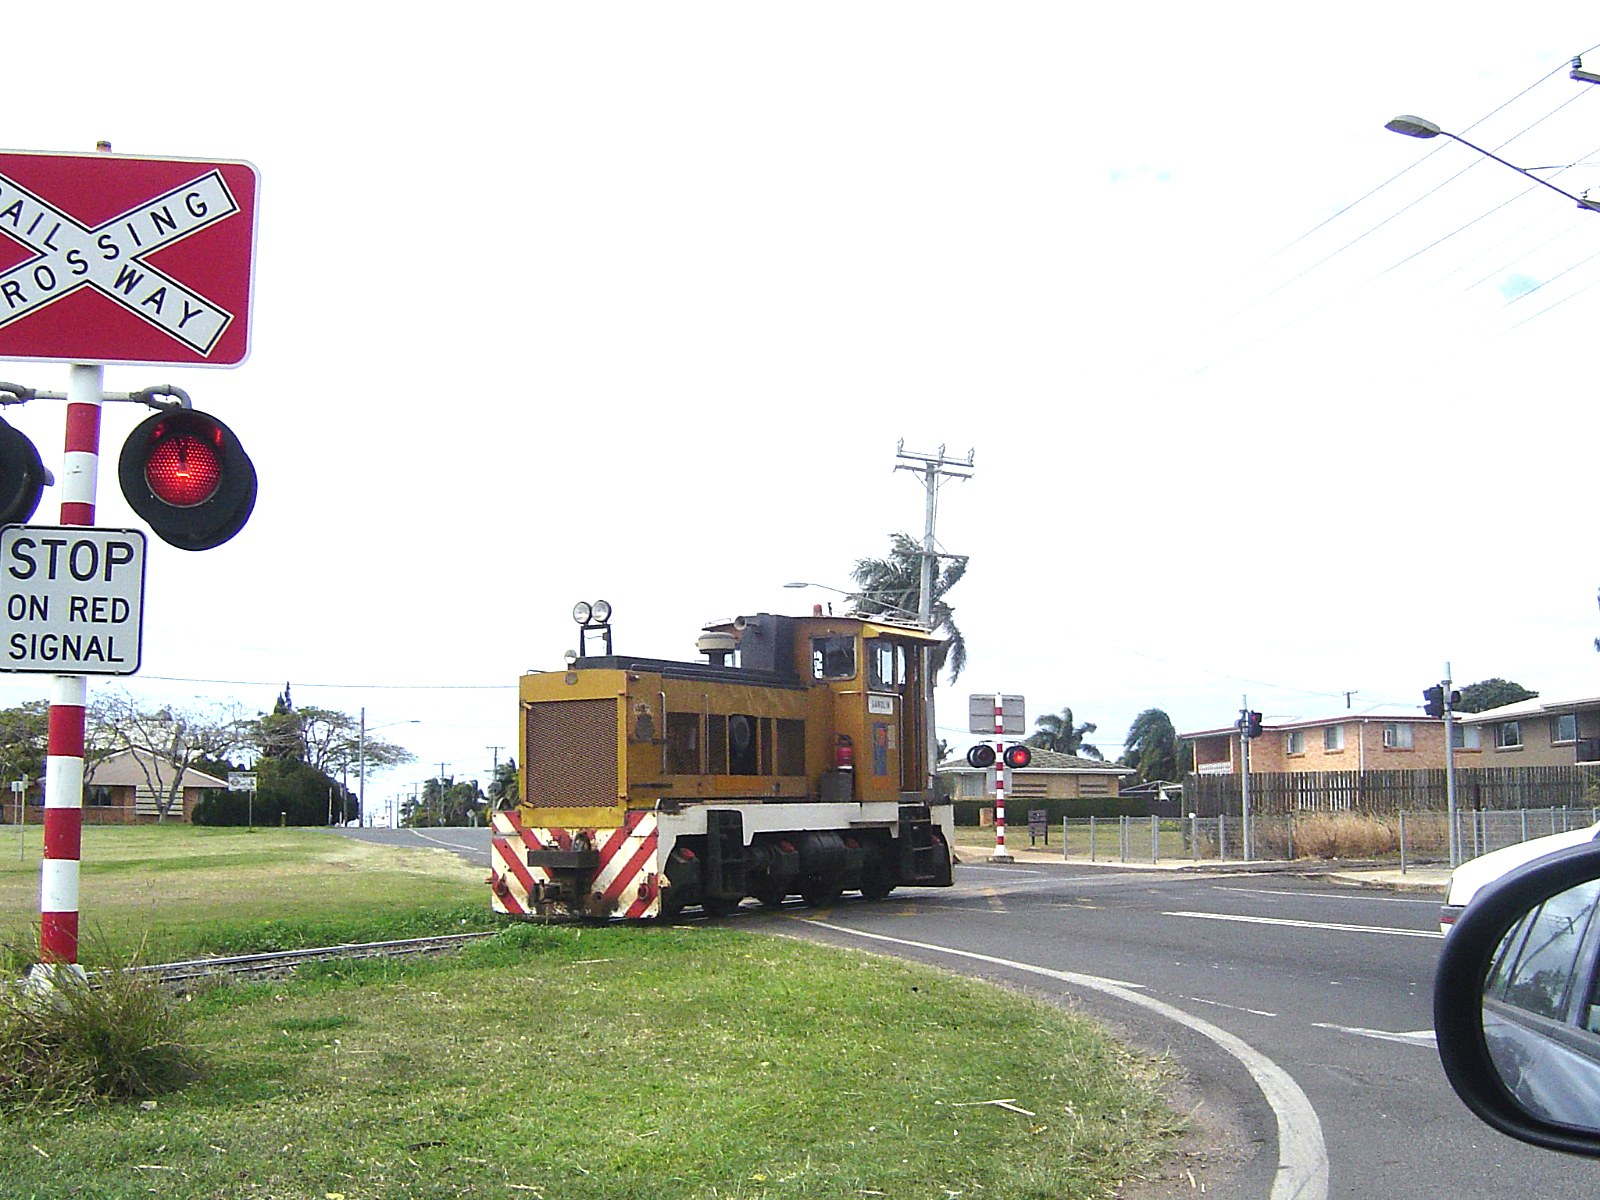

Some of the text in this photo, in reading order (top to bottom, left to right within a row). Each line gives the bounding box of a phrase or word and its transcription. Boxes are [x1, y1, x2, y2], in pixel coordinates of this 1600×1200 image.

[0, 187, 203, 329] AIL WAY
[1, 192, 208, 309] ROSSING
[8, 537, 134, 582] STOP
[7, 594, 130, 624] ON RED
[8, 633, 124, 662] SIGNAL
